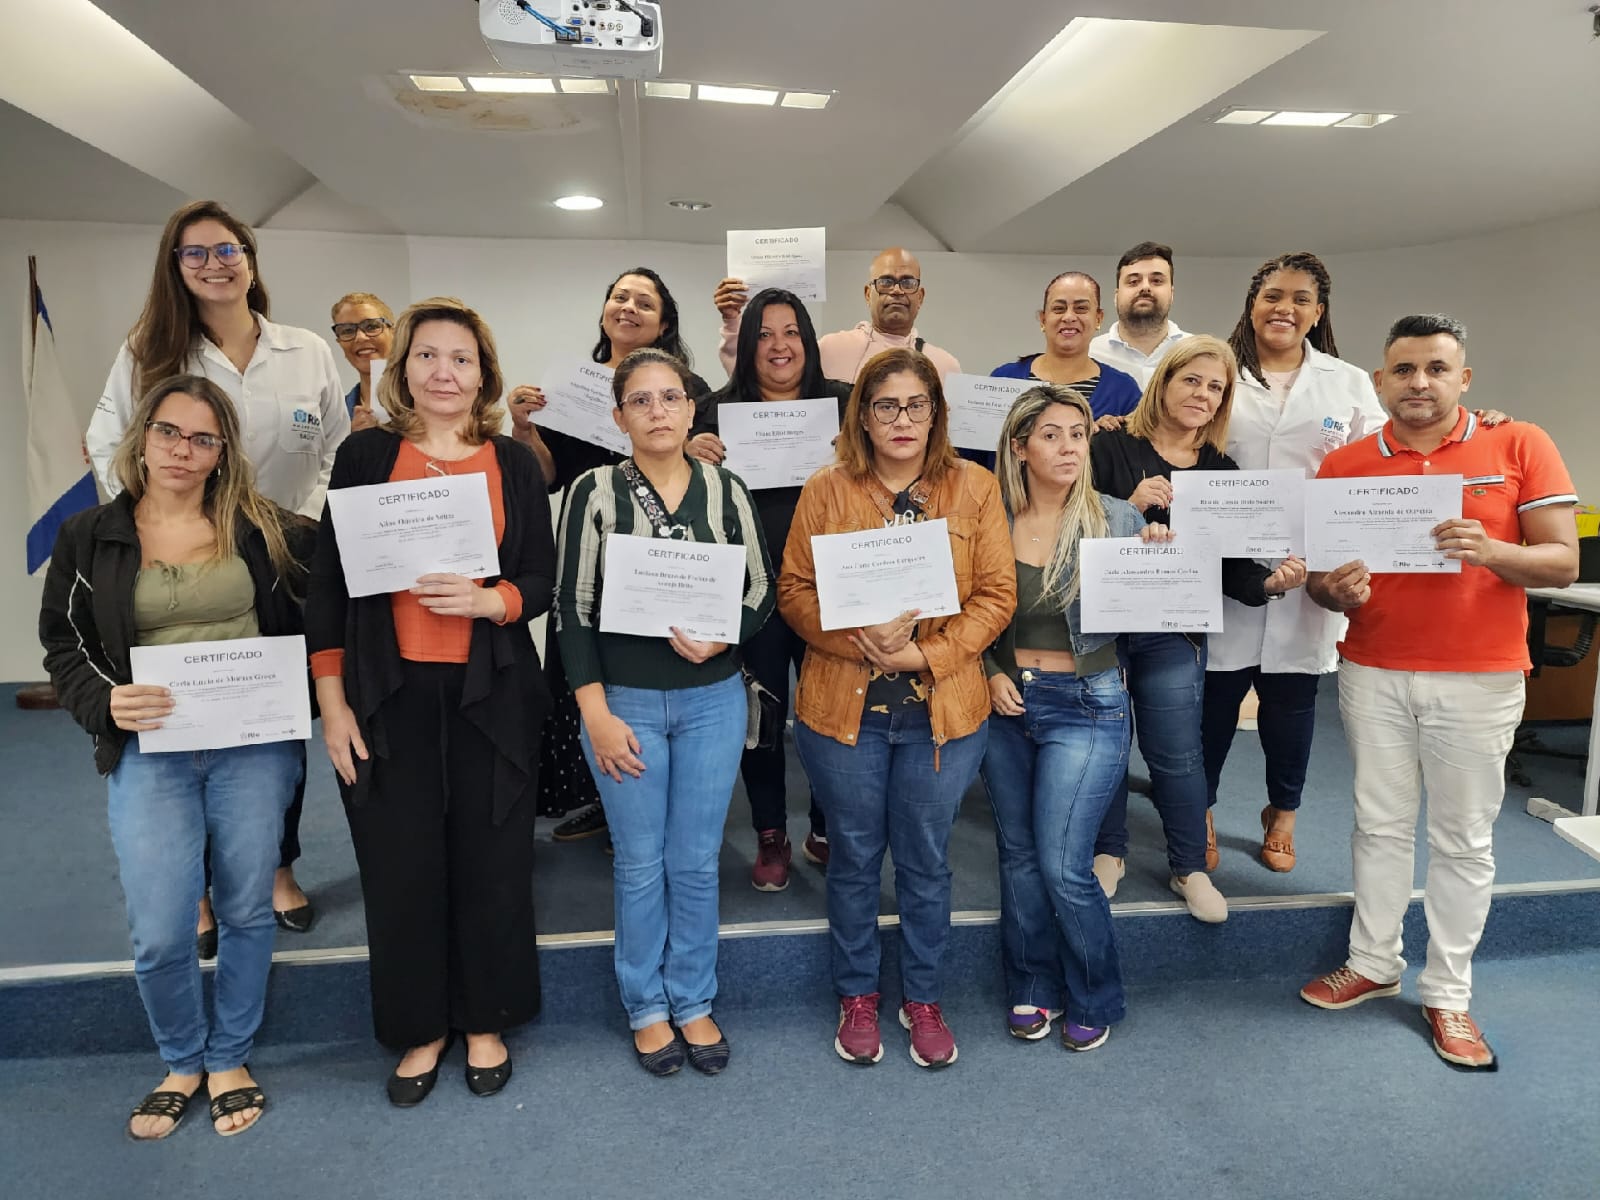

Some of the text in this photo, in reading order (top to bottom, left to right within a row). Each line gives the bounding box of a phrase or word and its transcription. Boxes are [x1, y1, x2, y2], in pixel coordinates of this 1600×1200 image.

[580, 368, 613, 382] CERTIFIC
[974, 384, 1021, 393] CERTIFICADO
[753, 410, 806, 419] CERTIFICADO
[378, 489, 450, 506] CERTIFICADO
[1349, 487, 1419, 496] CERTIFICADO
[851, 536, 912, 550] CERTIFICADO
[648, 548, 710, 562] CERTIFICADO
[1119, 547, 1184, 556] CERTIFICADO
[184, 651, 263, 664] CERTIFICADO
